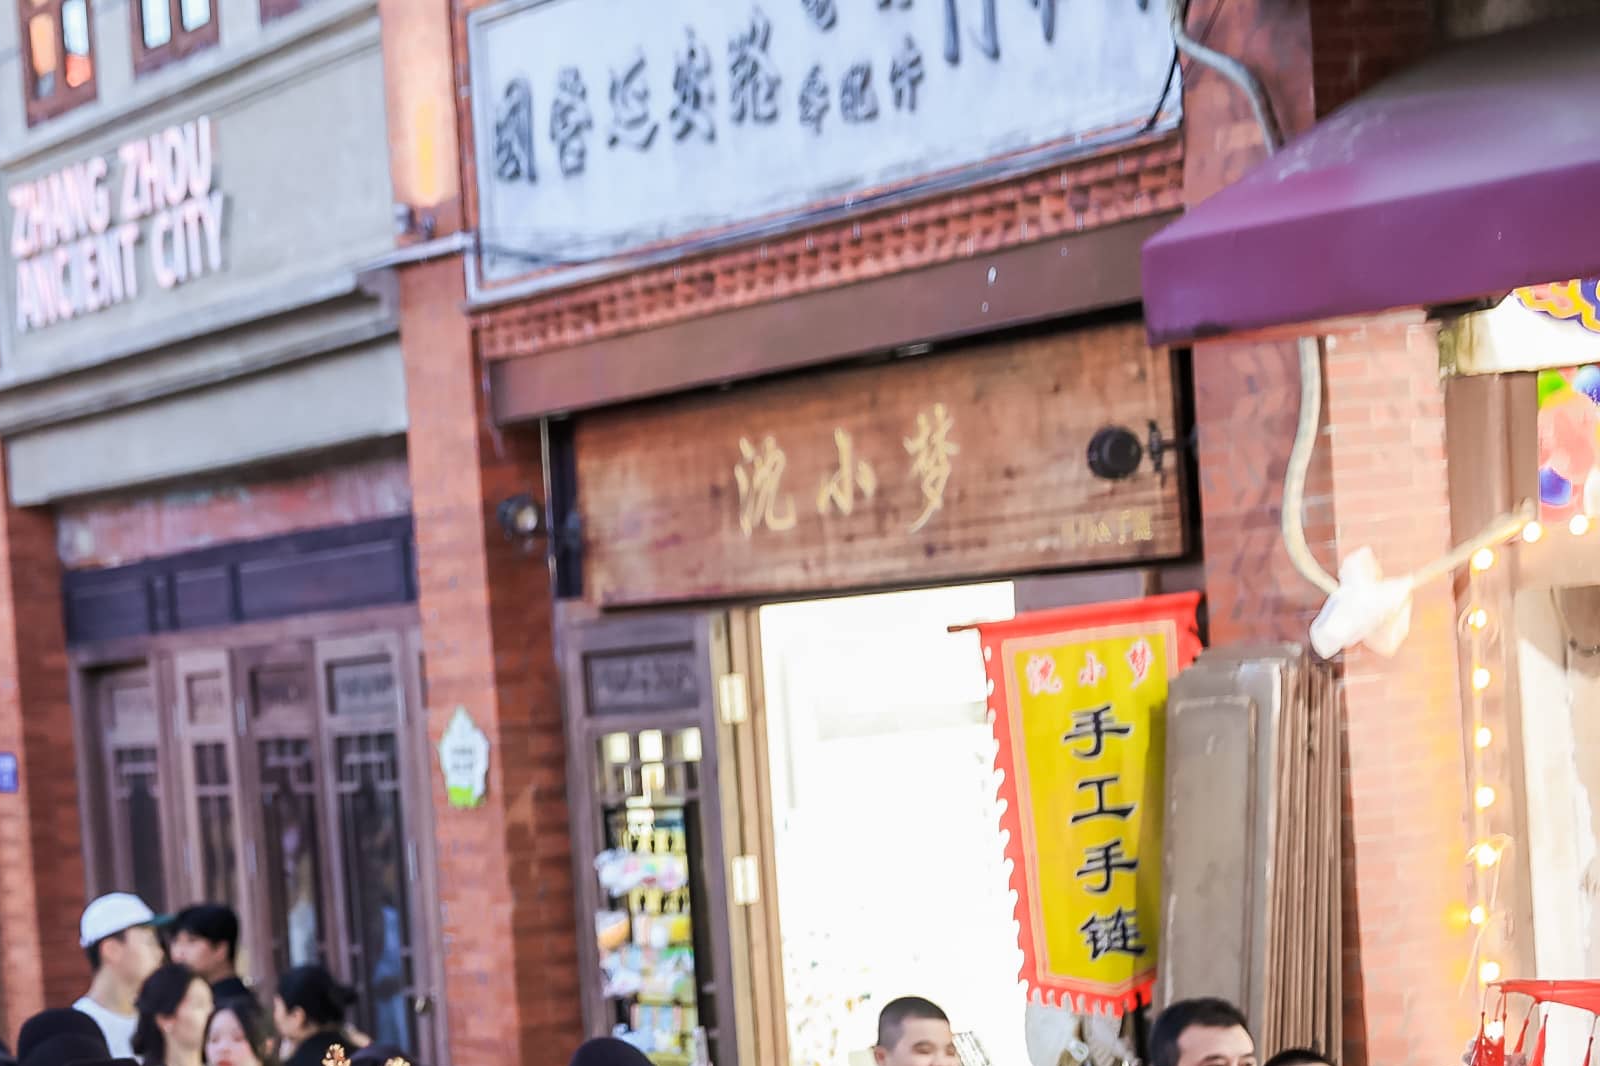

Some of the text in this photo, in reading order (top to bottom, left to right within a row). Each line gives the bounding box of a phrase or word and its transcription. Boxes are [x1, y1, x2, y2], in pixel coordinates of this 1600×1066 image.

[8, 115, 213, 259] ZHANG ZHOU
[17, 189, 224, 333] ANCIENT CITY
[734, 402, 960, 537] 沈小梦
[1026, 638, 1152, 695] 沈小梦
[1064, 704, 1148, 960] 手工手链
